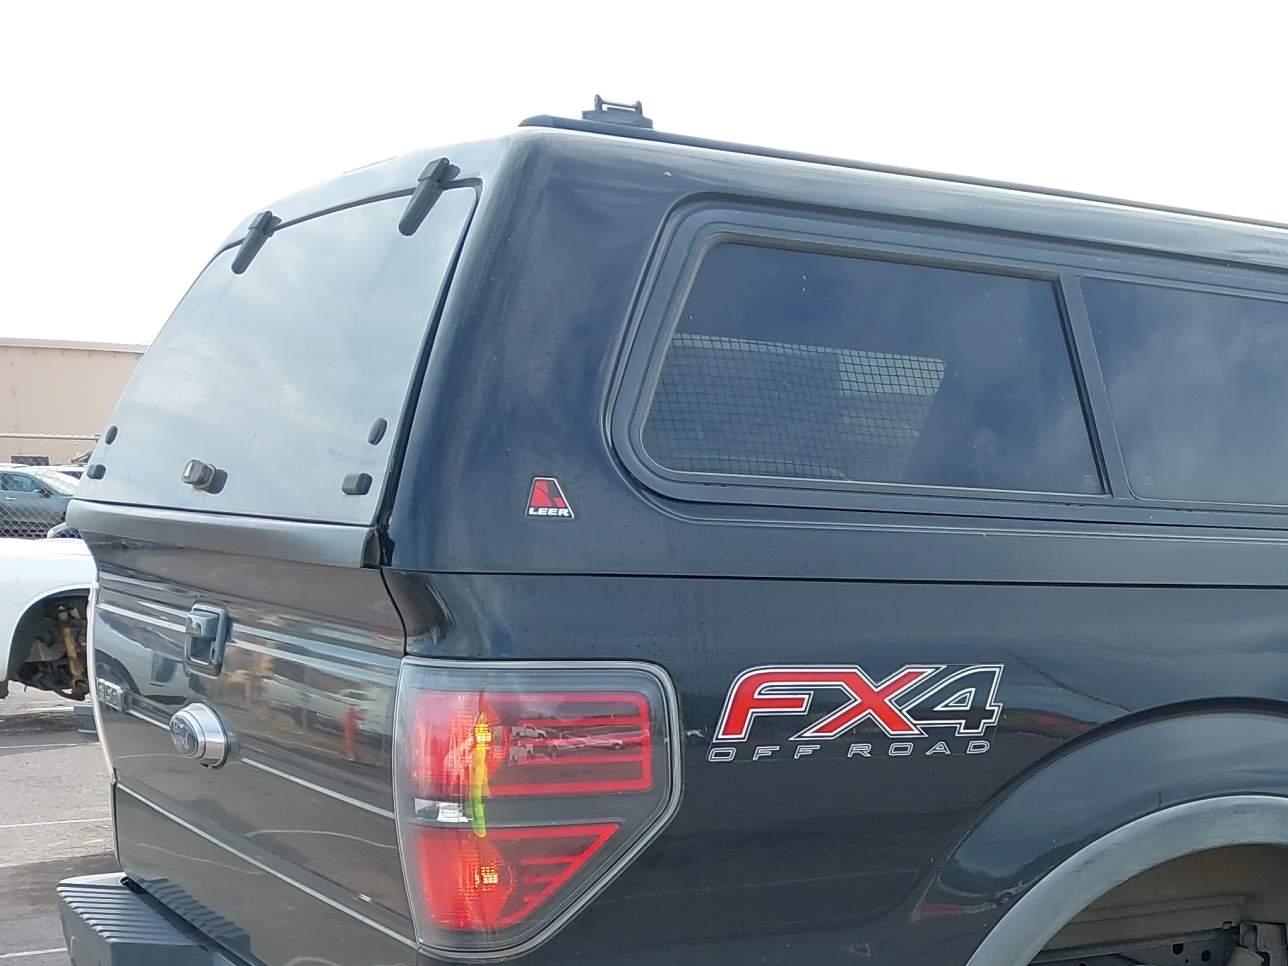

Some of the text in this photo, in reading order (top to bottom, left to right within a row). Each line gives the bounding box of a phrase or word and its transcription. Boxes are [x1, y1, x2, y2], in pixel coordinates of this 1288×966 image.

[528, 507, 570, 517] LEER
[713, 664, 1004, 742] FX4
[708, 740, 991, 762] OFF ROAD
